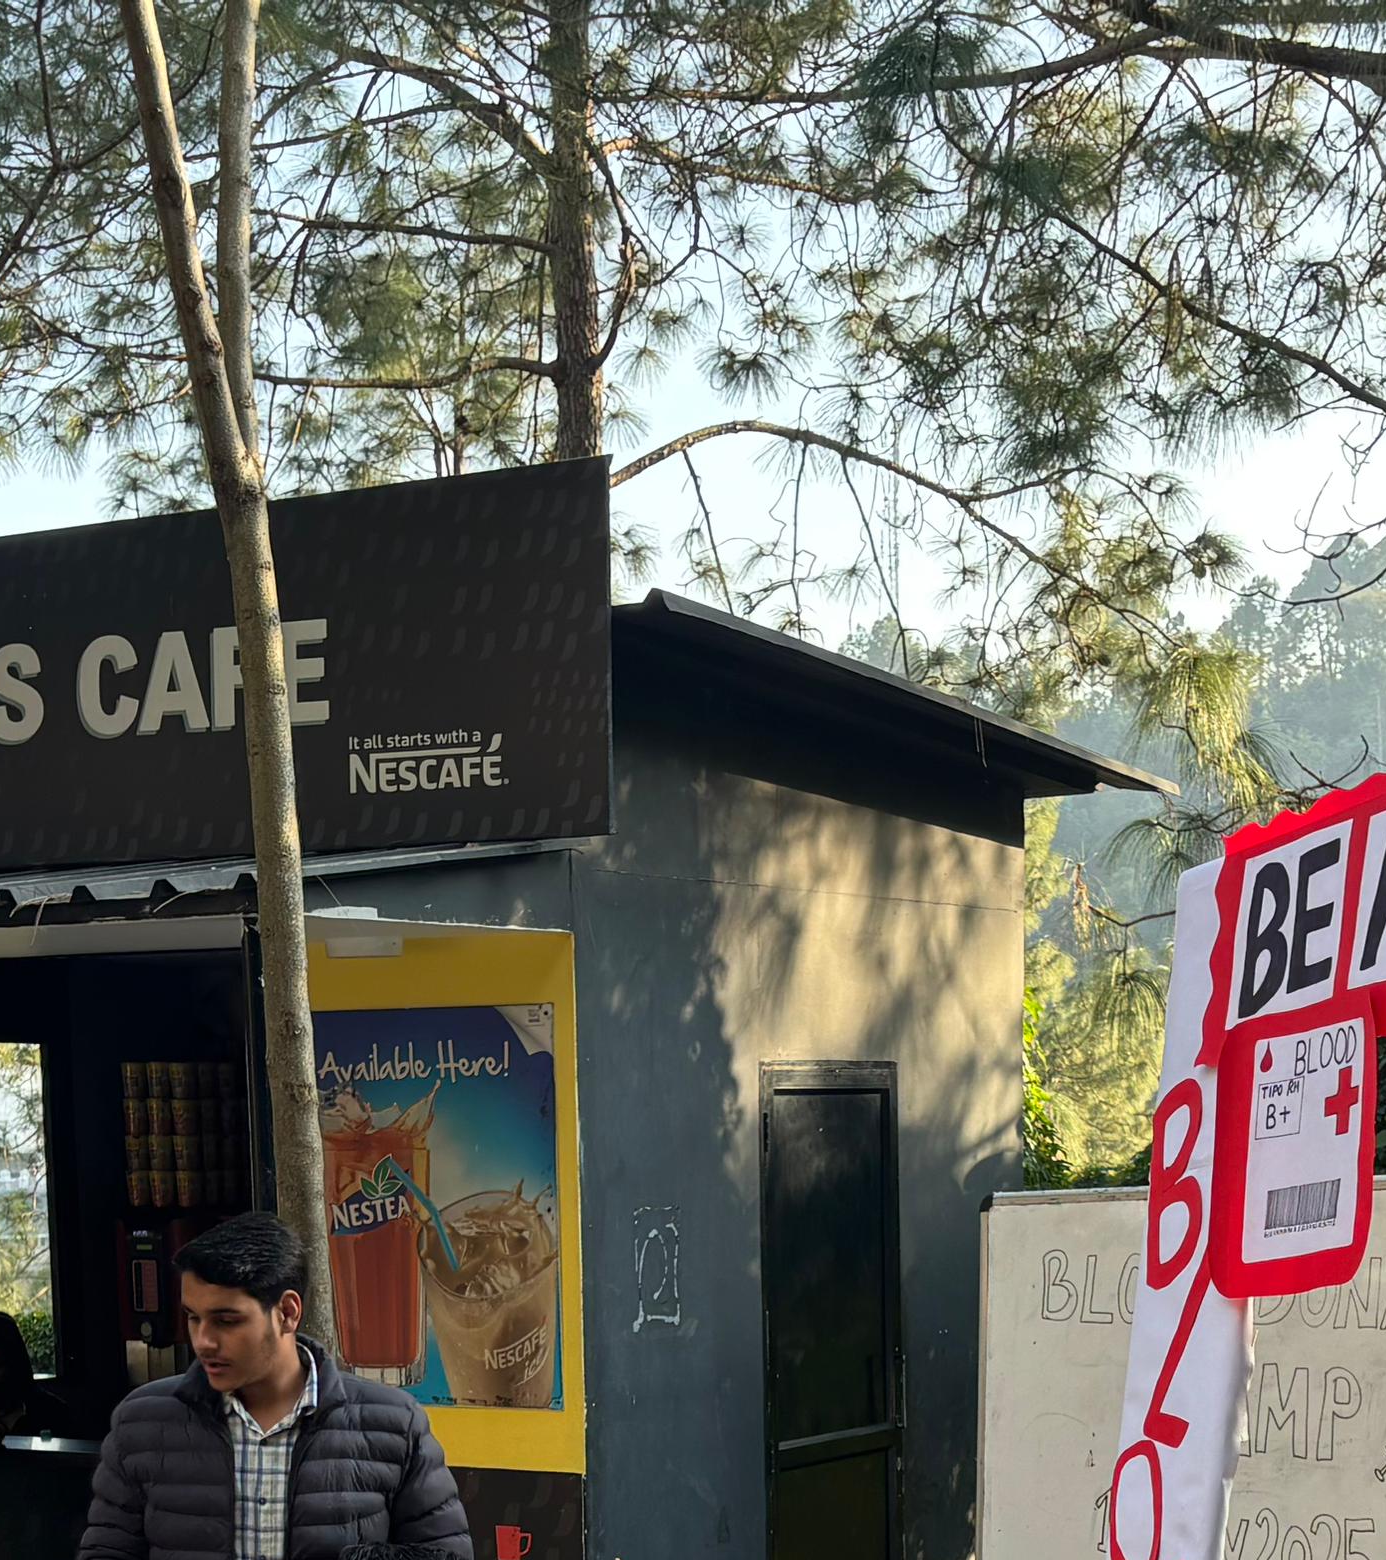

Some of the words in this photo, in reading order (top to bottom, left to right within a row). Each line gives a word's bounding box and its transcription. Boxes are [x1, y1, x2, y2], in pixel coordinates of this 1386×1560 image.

[349, 736, 360, 750] It
[363, 734, 384, 749] all
[386, 732, 431, 748] starts
[435, 729, 468, 744] with
[472, 731, 481, 742] a
[349, 733, 503, 794] NESCAFÉ
[1238, 838, 1343, 1018] BE
[318, 1041, 431, 1082] Available
[436, 1040, 511, 1083] Here!
[1294, 1025, 1357, 1076] BLOOD
[1262, 1084, 1283, 1100] TIPO
[1286, 1080, 1300, 1095] RH
[1265, 1103, 1292, 1130] B+
[332, 1195, 411, 1230] NESTEA
